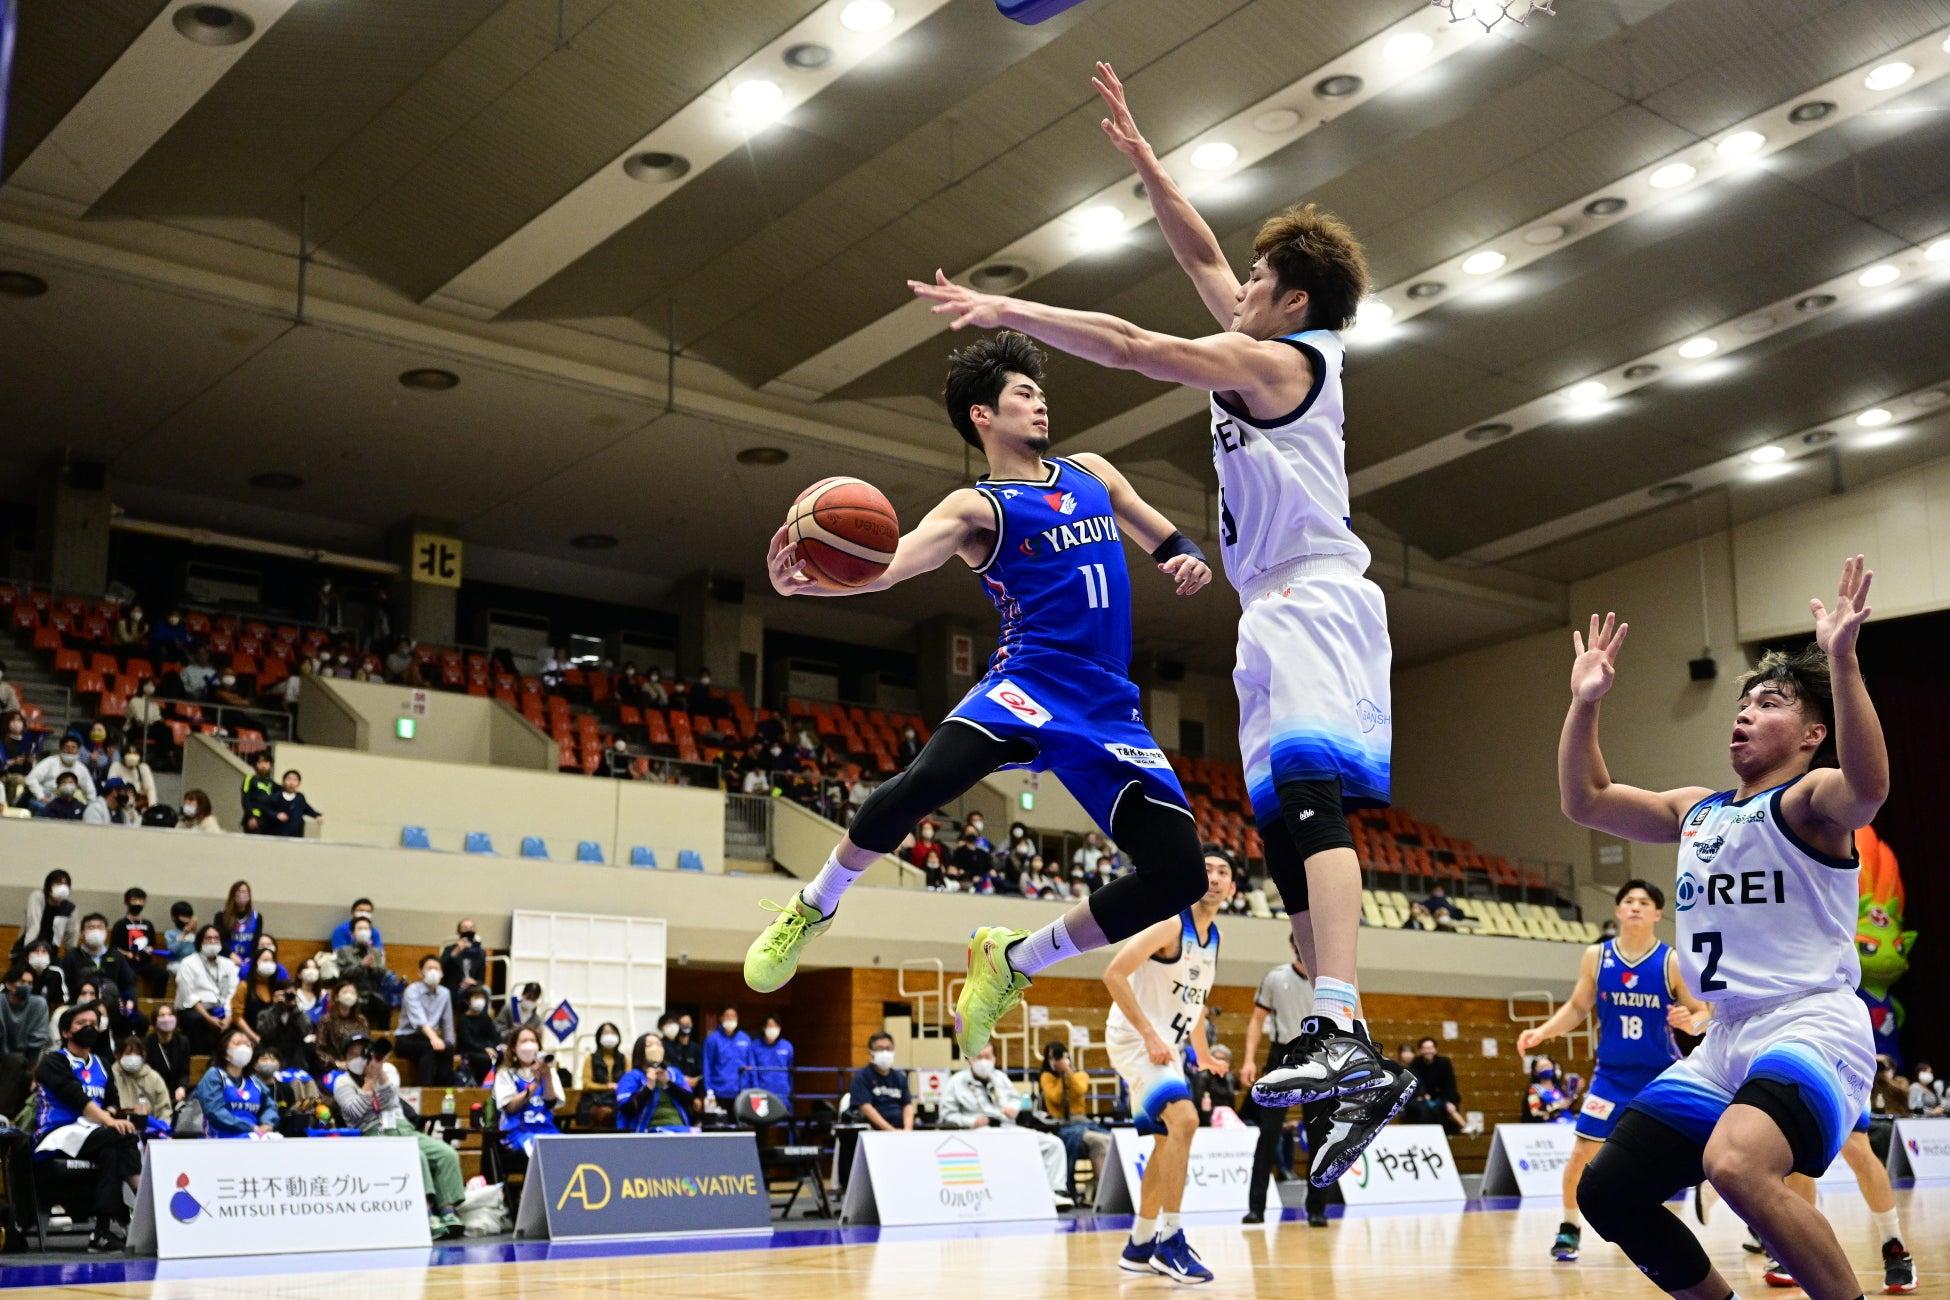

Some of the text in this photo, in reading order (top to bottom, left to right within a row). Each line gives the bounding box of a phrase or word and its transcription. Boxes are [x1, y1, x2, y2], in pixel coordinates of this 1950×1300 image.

[1041, 515, 1121, 553] YAZUYA
[419, 542, 456, 579] 北
[1077, 563, 1110, 609] 11
[1691, 931, 1728, 993] 2
[1611, 991, 1661, 1009] YAZUYA
[1619, 1015, 1644, 1040] 18
[1375, 1144, 1444, 1181] やずや
[217, 1173, 410, 1200] 三井不動産グループ
[218, 1199, 413, 1218] MITSUI FUDOSAN GROUP
